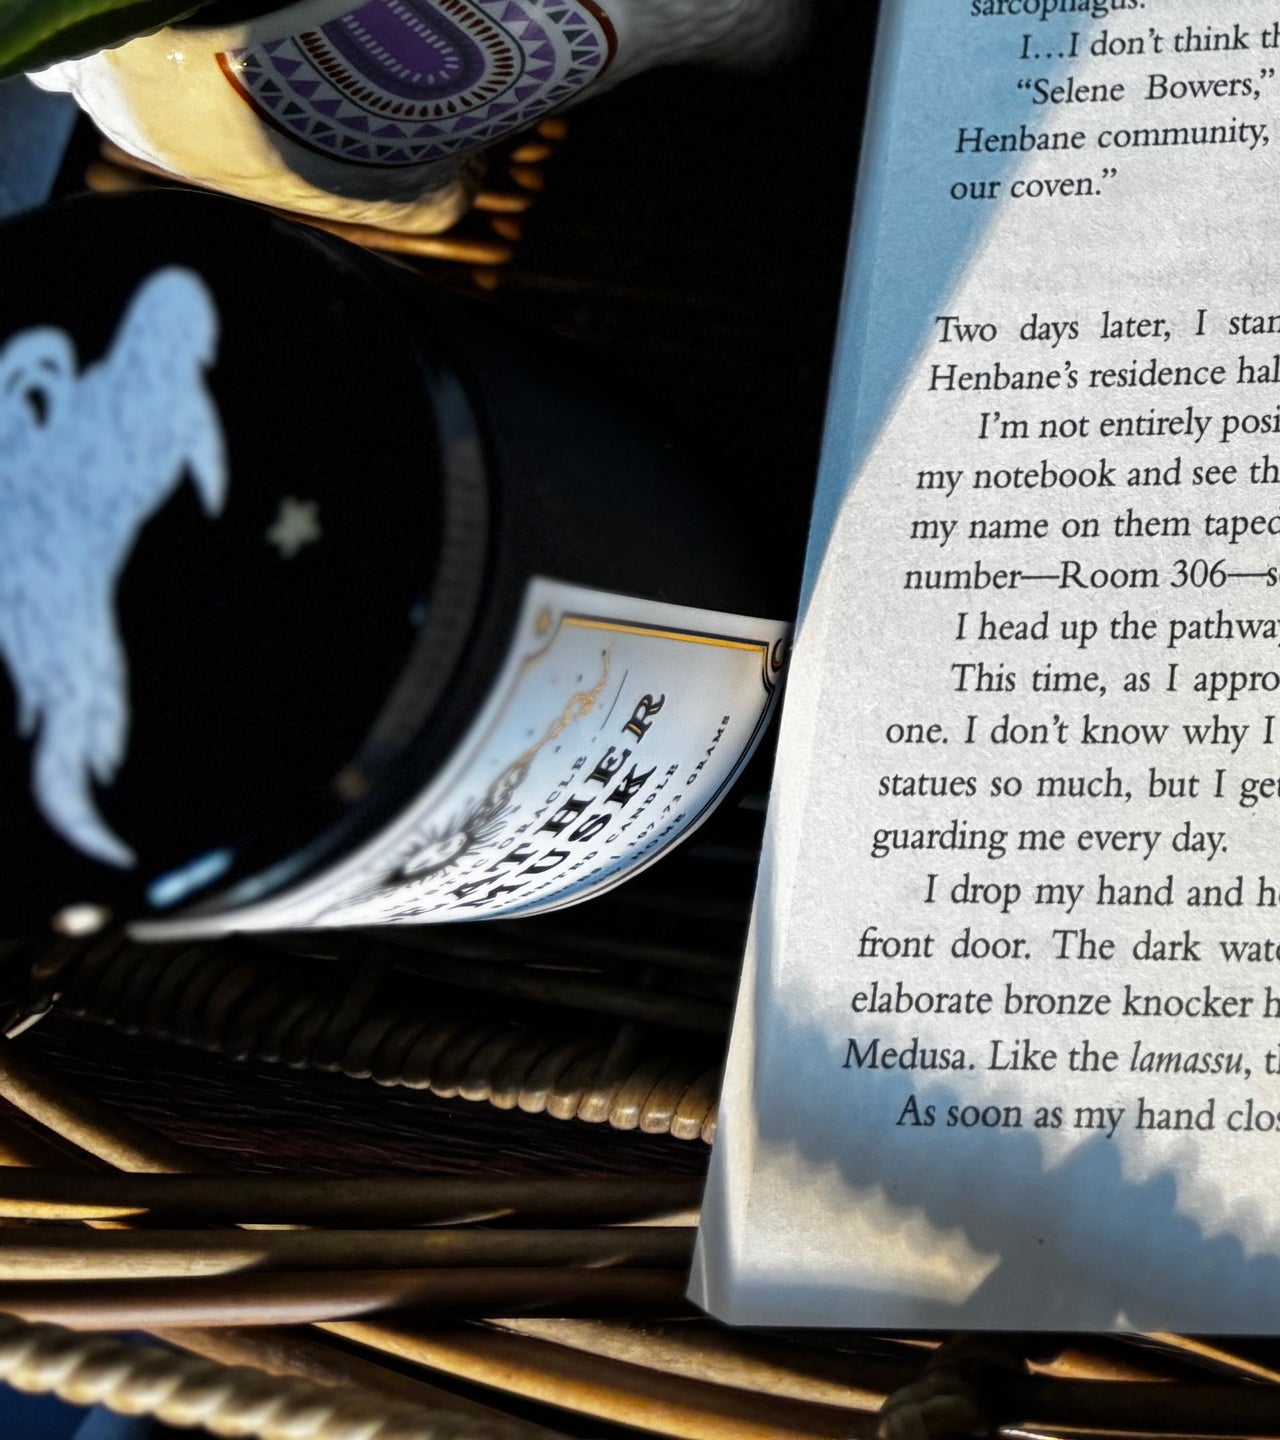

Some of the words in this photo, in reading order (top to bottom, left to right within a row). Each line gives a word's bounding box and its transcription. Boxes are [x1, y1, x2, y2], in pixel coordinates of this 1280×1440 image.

[1016, 76, 1126, 106] “Selene
[1144, 67, 1276, 101] Bowers,”
[949, 180, 1002, 201] our
[1009, 167, 1118, 199] coven.”
[927, 359, 1079, 392] Henbane’s
[1088, 357, 1227, 389] residence
[685, 714, 731, 787] GRAMS
[497, 754, 589, 851] ORACLE
[604, 762, 680, 845] CANDLE
[449, 763, 658, 911] MUSK
[869, 818, 1009, 861] guarding
[1016, 829, 1066, 852] me
[1076, 829, 1162, 862] every
[1171, 820, 1228, 862] day.
[850, 980, 994, 1016] elaborate
[1003, 982, 1112, 1017] bronze
[1121, 983, 1255, 1019] knocker
[841, 1036, 976, 1071] Medusa.
[987, 1038, 1058, 1072] Like
[1068, 1039, 1120, 1073] the
[1129, 1039, 1252, 1081] lamassu,
